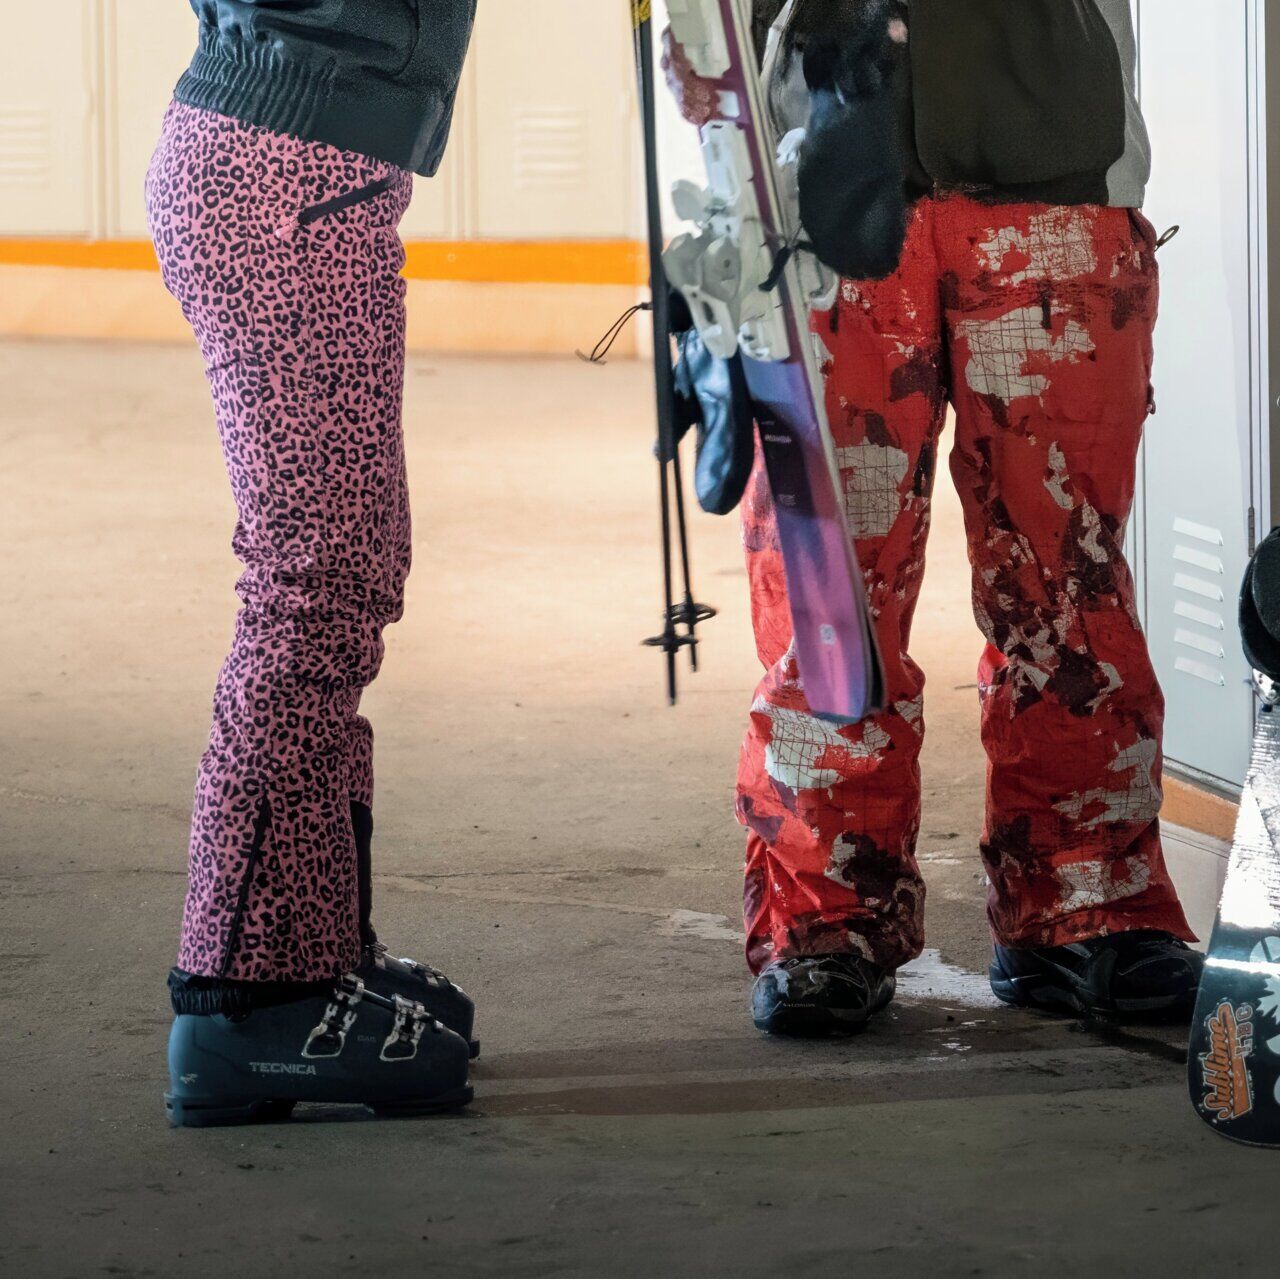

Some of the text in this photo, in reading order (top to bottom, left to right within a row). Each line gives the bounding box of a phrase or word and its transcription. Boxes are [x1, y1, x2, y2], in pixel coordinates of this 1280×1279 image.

[1235, 1004, 1253, 1057] LBC
[248, 1061, 317, 1075] TECNICA
[1204, 1016, 1232, 1120] Sublime
